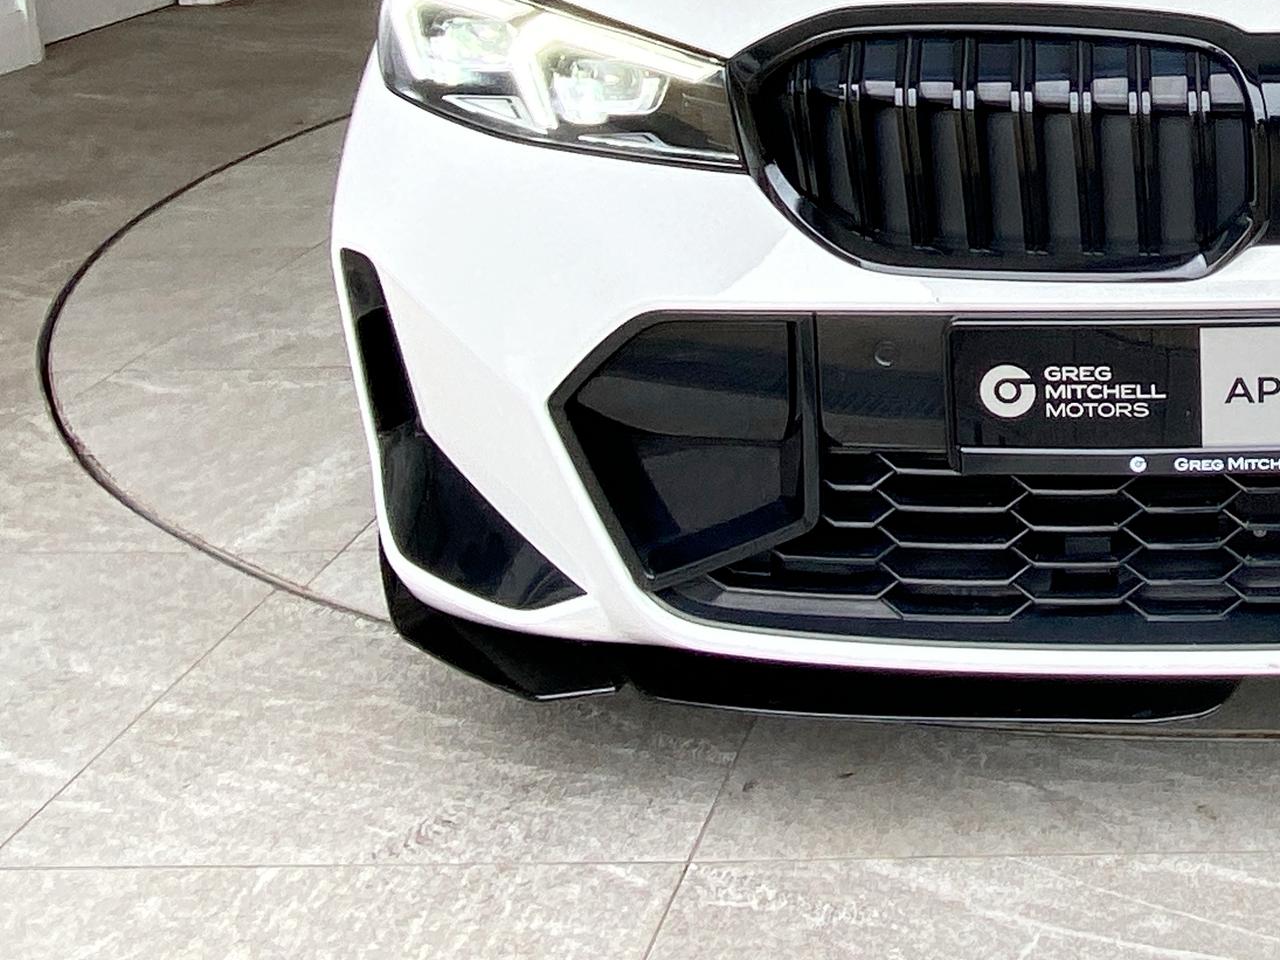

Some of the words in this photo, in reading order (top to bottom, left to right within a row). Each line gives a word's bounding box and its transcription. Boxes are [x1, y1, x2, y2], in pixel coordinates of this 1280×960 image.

[1044, 366, 1112, 381] GREG
[1045, 384, 1167, 399] MITCHELL
[1045, 402, 1150, 418] MOTORS
[1174, 457, 1224, 471] GREG
